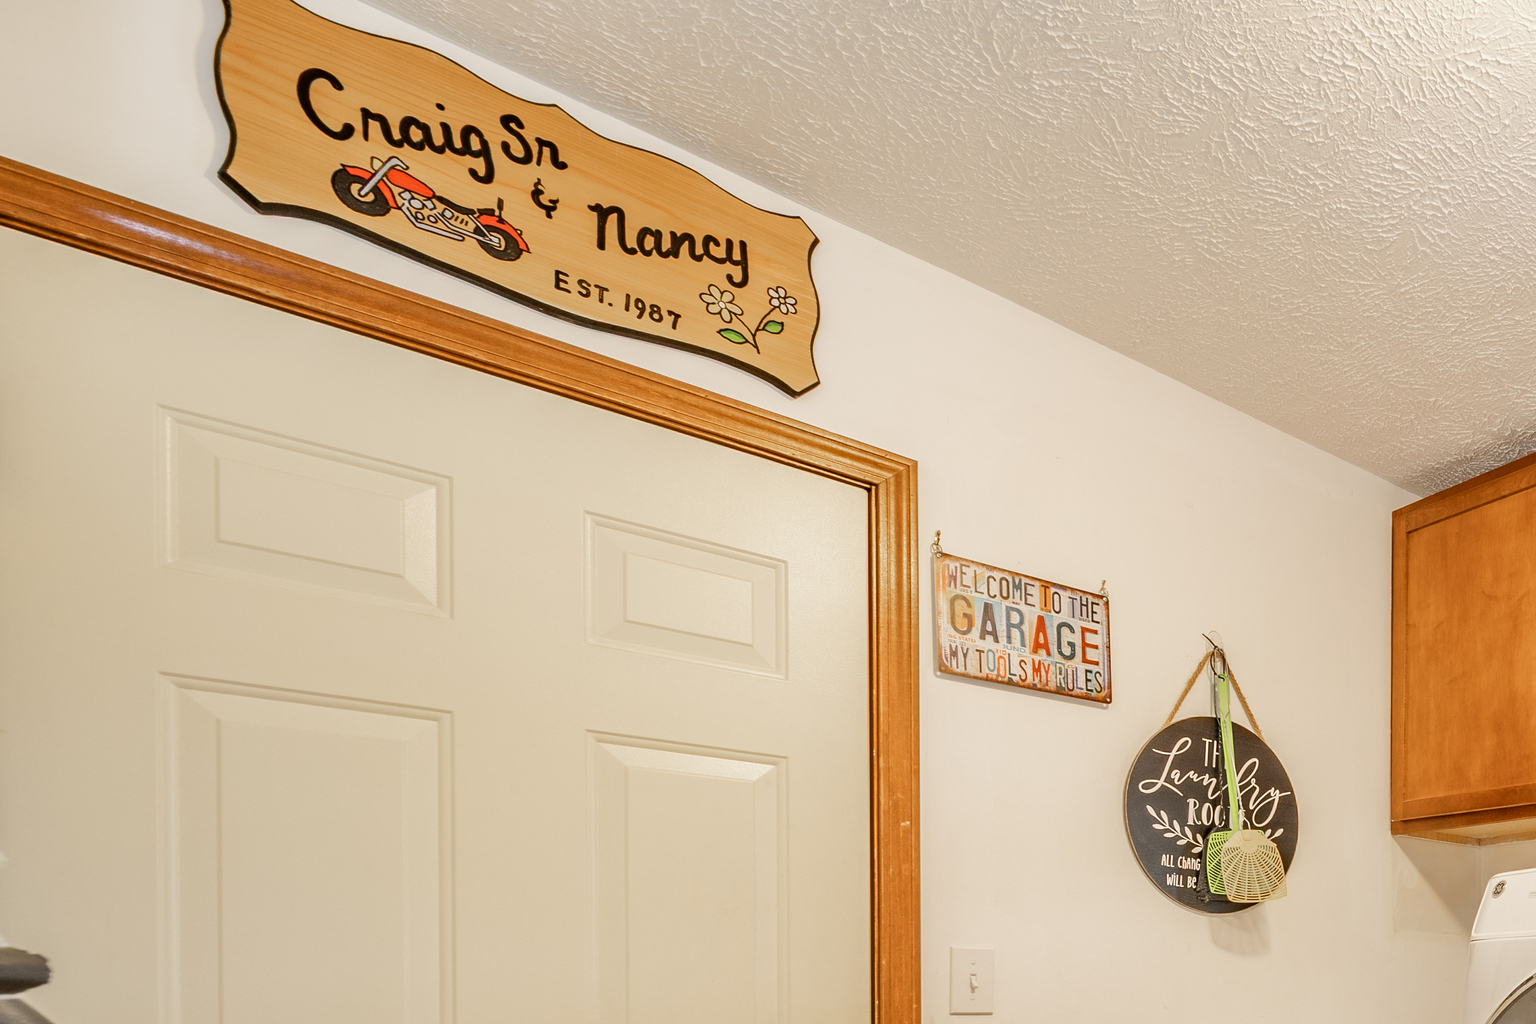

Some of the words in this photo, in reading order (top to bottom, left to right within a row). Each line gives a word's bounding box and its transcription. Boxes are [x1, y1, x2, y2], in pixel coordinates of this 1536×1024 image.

[296, 67, 495, 184] Craig
[499, 113, 568, 171] Sr
[530, 177, 560, 219] &
[587, 202, 750, 288] Nancy
[553, 270, 614, 309] EST.
[624, 293, 682, 331] 1987
[946, 563, 1036, 607] WELCOME
[1040, 584, 1062, 614] TO
[1067, 595, 1101, 625] THE
[950, 593, 1100, 666] GARAGE
[948, 643, 969, 671] MY
[975, 648, 1028, 683] TOOLS
[1031, 657, 1051, 687] MY
[1055, 660, 1103, 694] RULES
[1202, 737, 1226, 769] TH
[1161, 854, 1175, 868] ALL
